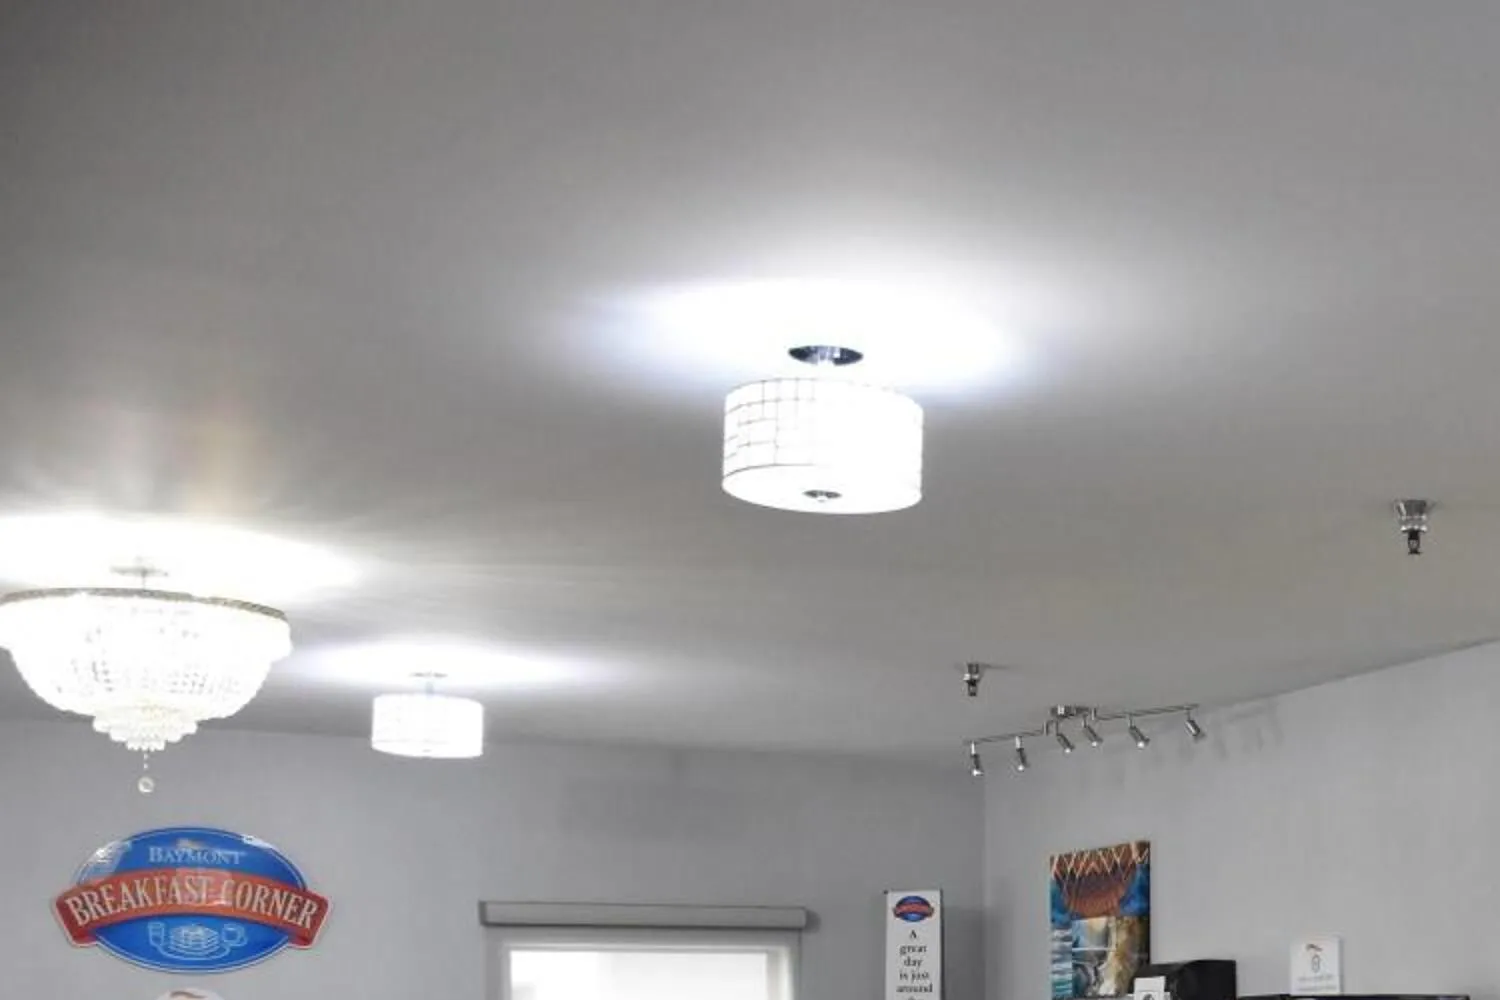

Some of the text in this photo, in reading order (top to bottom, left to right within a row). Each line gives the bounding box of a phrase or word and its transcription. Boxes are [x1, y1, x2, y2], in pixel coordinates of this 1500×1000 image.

[149, 846, 240, 865] BAYMONT
[65, 875, 319, 930] BREAKFAST CORNER
[909, 929, 917, 939] A
[899, 944, 927, 955] great
[903, 956, 923, 967] day
[896, 982, 933, 993] around
